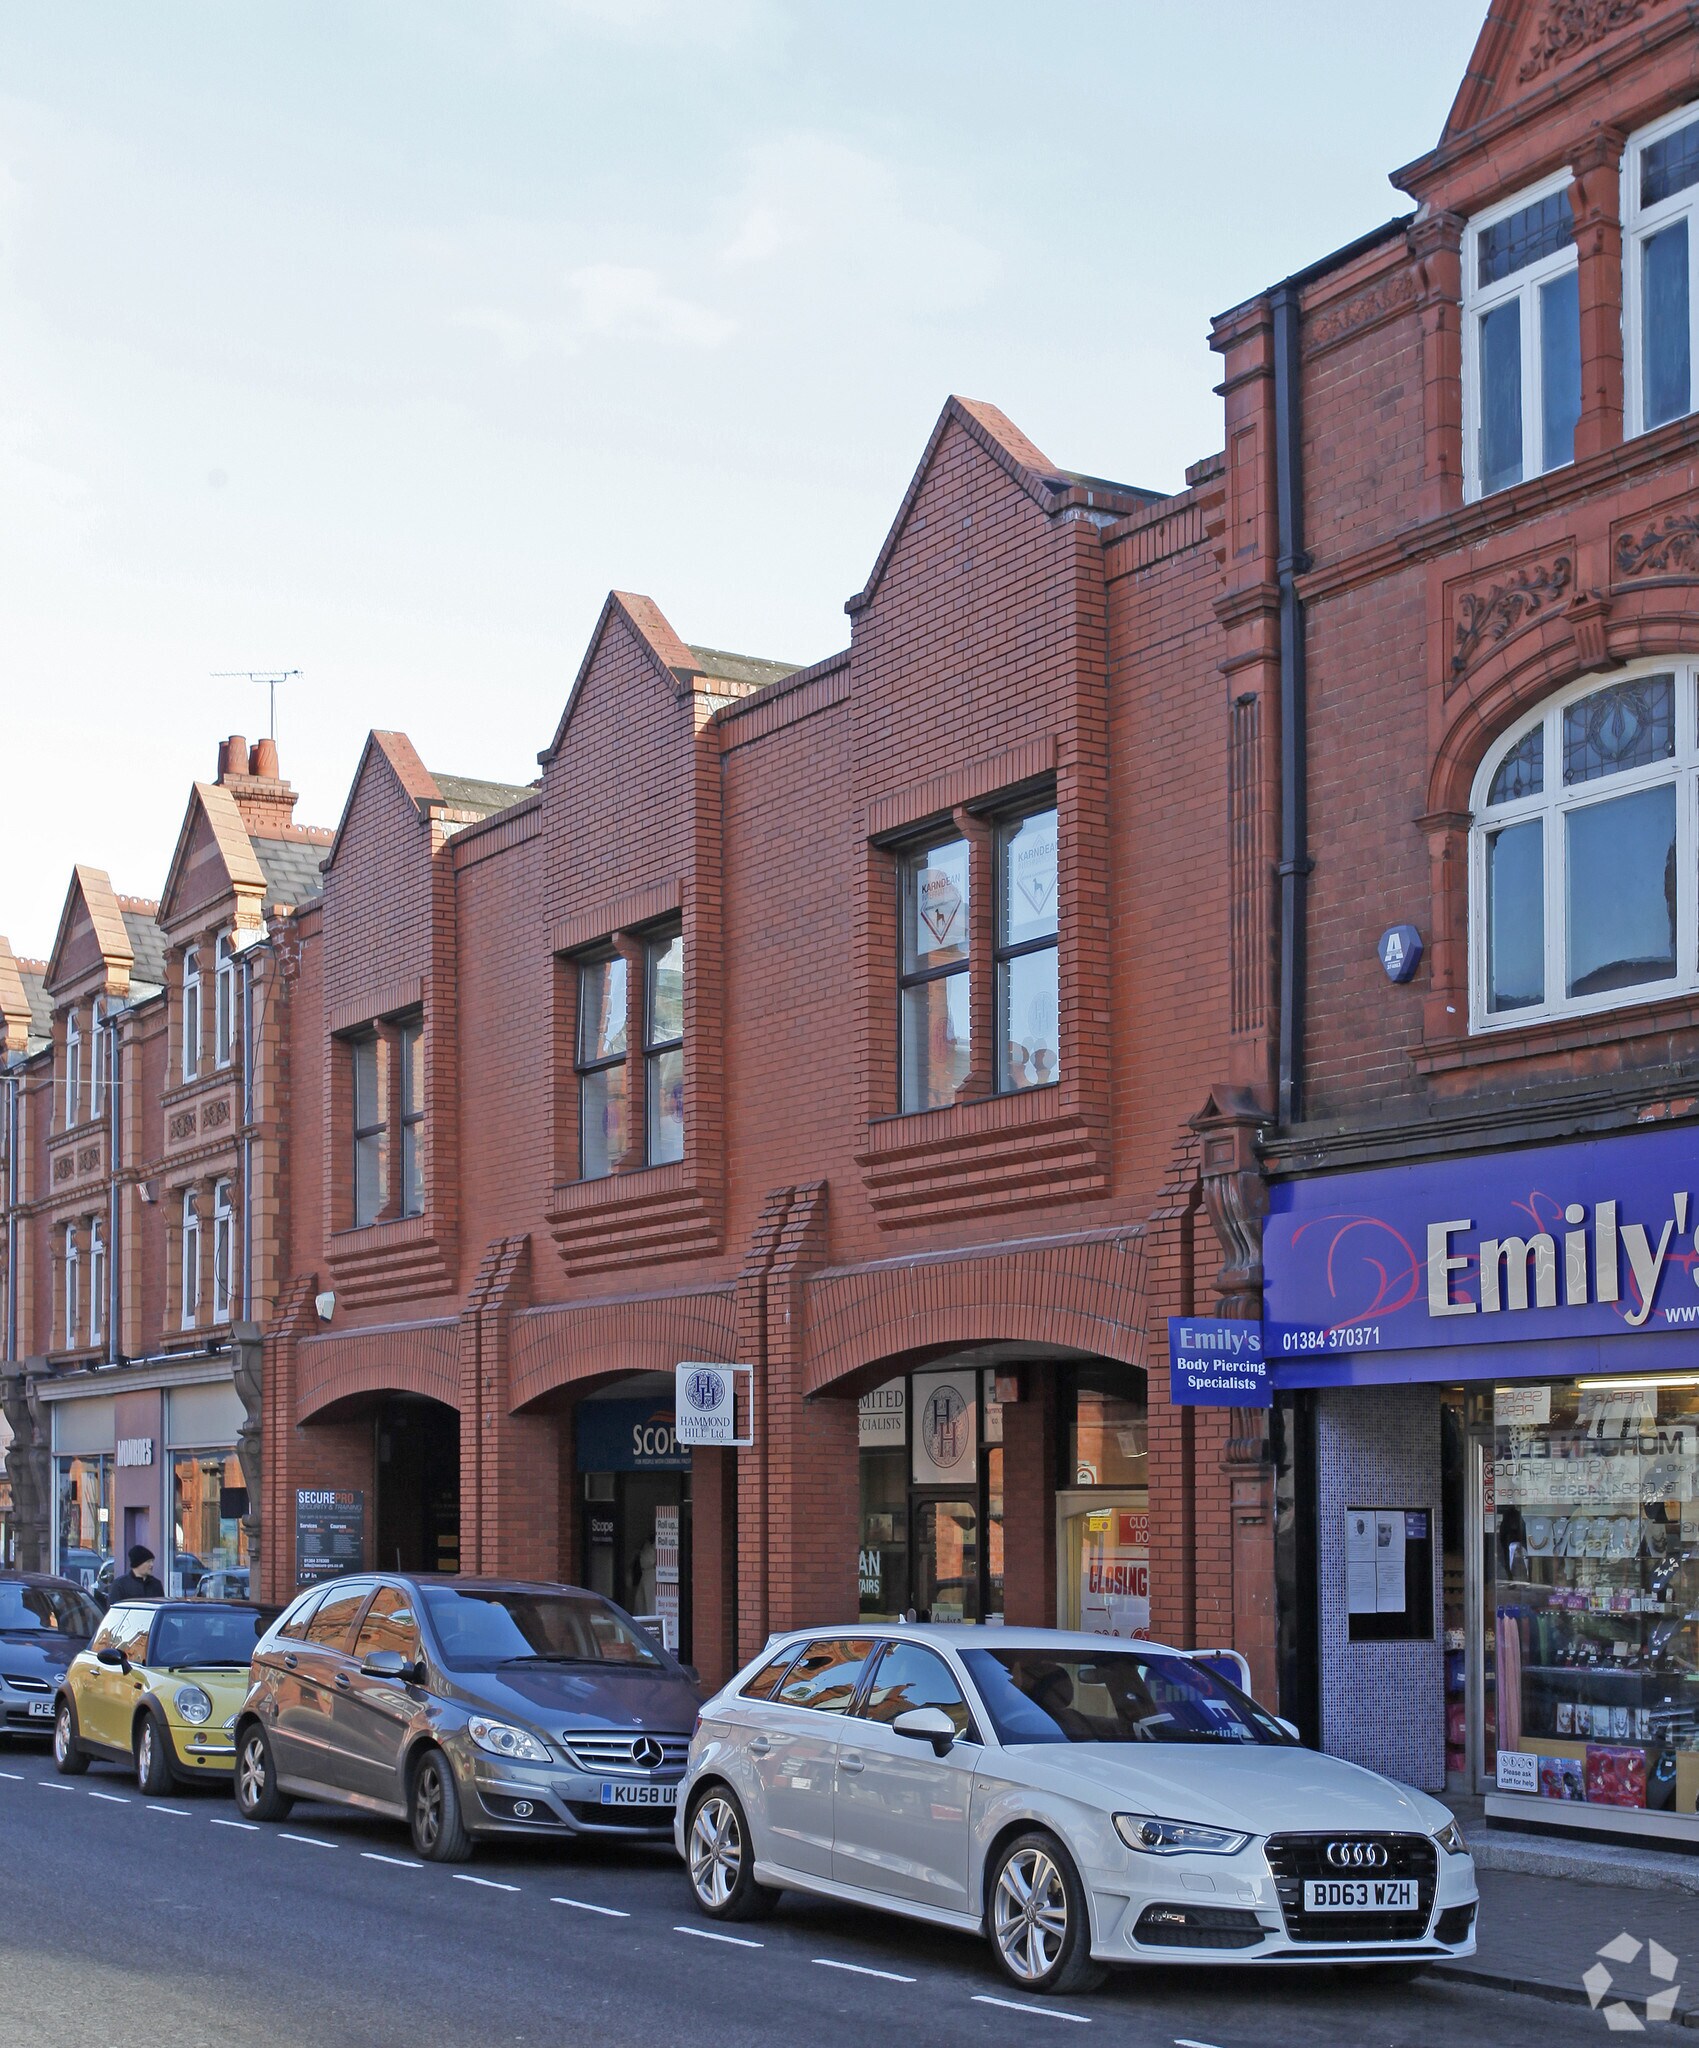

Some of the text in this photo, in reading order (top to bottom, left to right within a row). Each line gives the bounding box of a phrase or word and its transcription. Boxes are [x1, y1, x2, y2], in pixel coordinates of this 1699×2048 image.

[1018, 843, 1057, 862] KARNDEA
[921, 873, 961, 894] KARNDEAN
[1179, 1327, 1261, 1355] Emily's
[1282, 1326, 1380, 1351] 01384 370371
[1177, 1357, 1267, 1376] Body Piercing
[1187, 1375, 1257, 1390] Specialists
[680, 1416, 731, 1427] HAMMOND
[684, 1428, 727, 1439] HILL Ltd.
[591, 1518, 614, 1536] Scope
[1129, 1516, 1149, 1529] CLO
[1088, 1564, 1148, 1598] CLOSING
[1503, 1768, 1532, 1778] Please ask
[1500, 1777, 1535, 1788] staff for help
[615, 1786, 659, 1803] KU58
[1313, 1883, 1411, 1906] BD63 WZH
